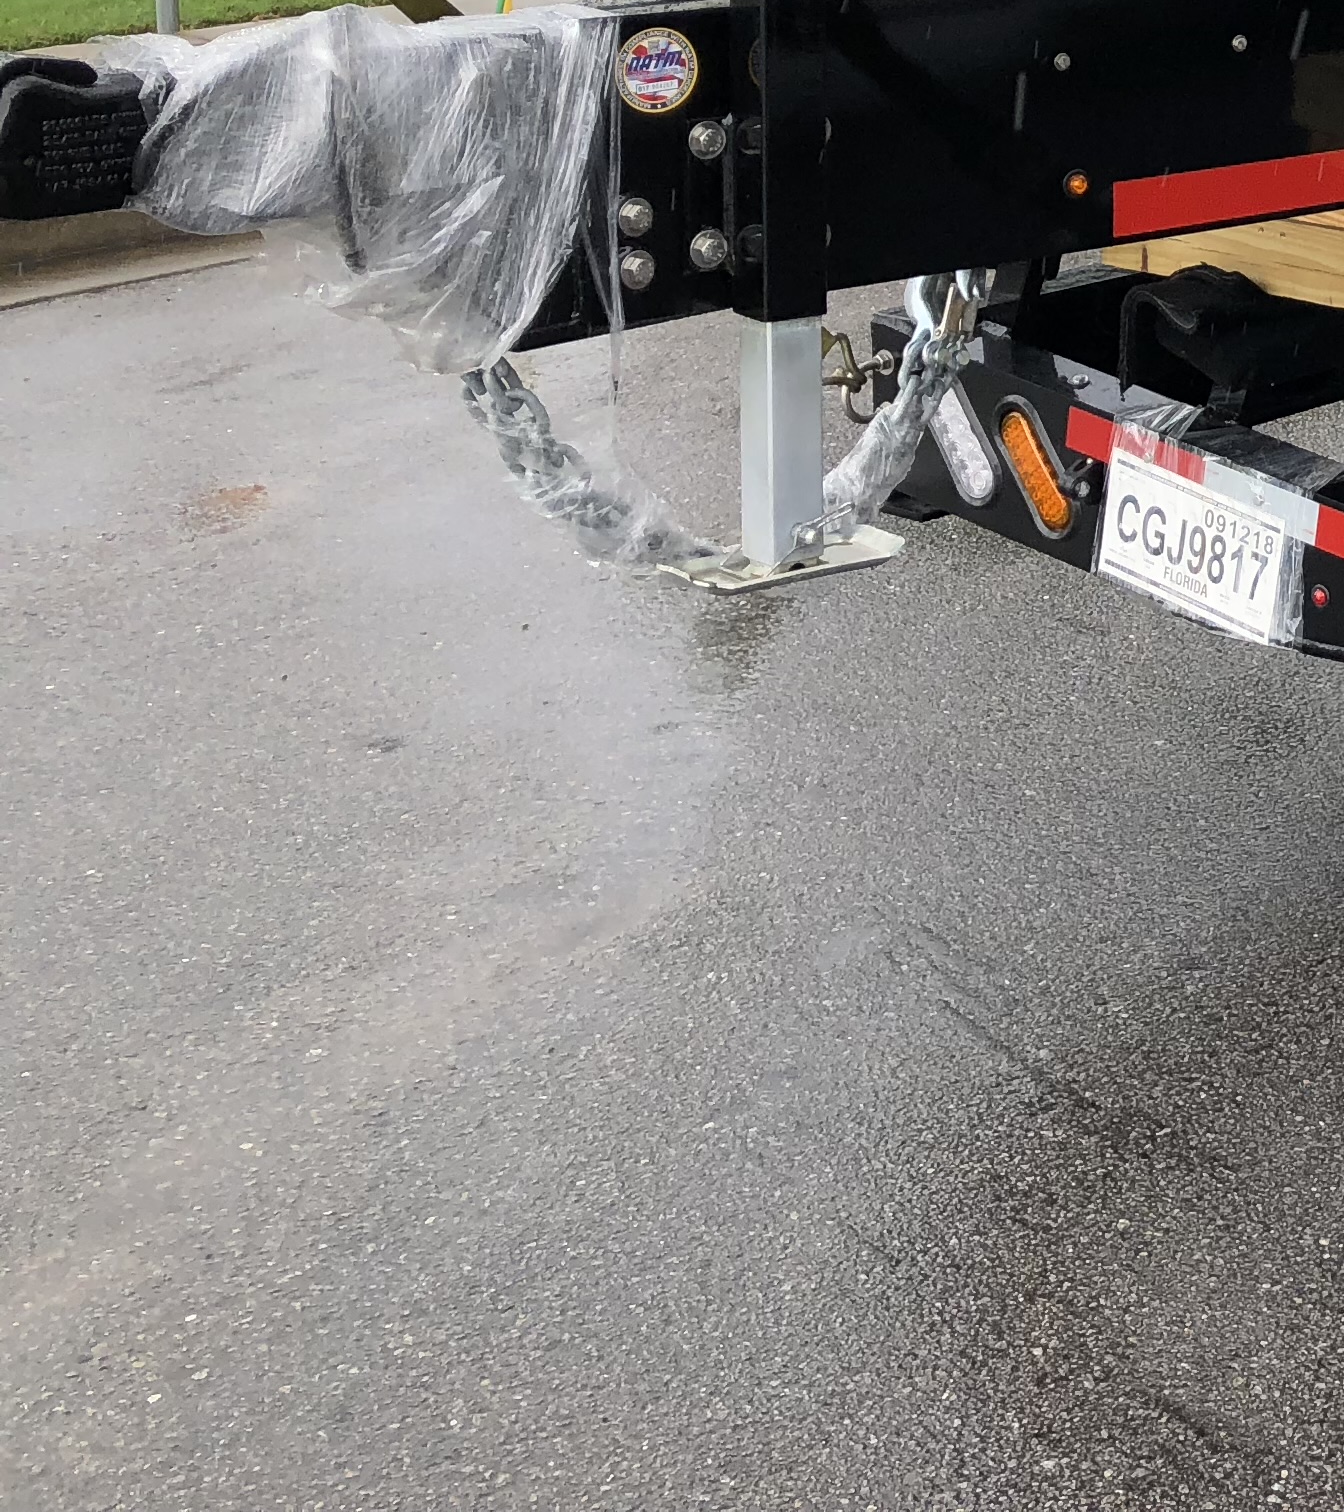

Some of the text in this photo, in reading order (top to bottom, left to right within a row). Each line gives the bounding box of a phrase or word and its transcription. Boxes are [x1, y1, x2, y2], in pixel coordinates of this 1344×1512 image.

[627, 50, 683, 72] NATM
[1116, 494, 1269, 601] CGJ9817
[1204, 508, 1274, 555] 091218
[1163, 566, 1208, 599] FLORIDA
